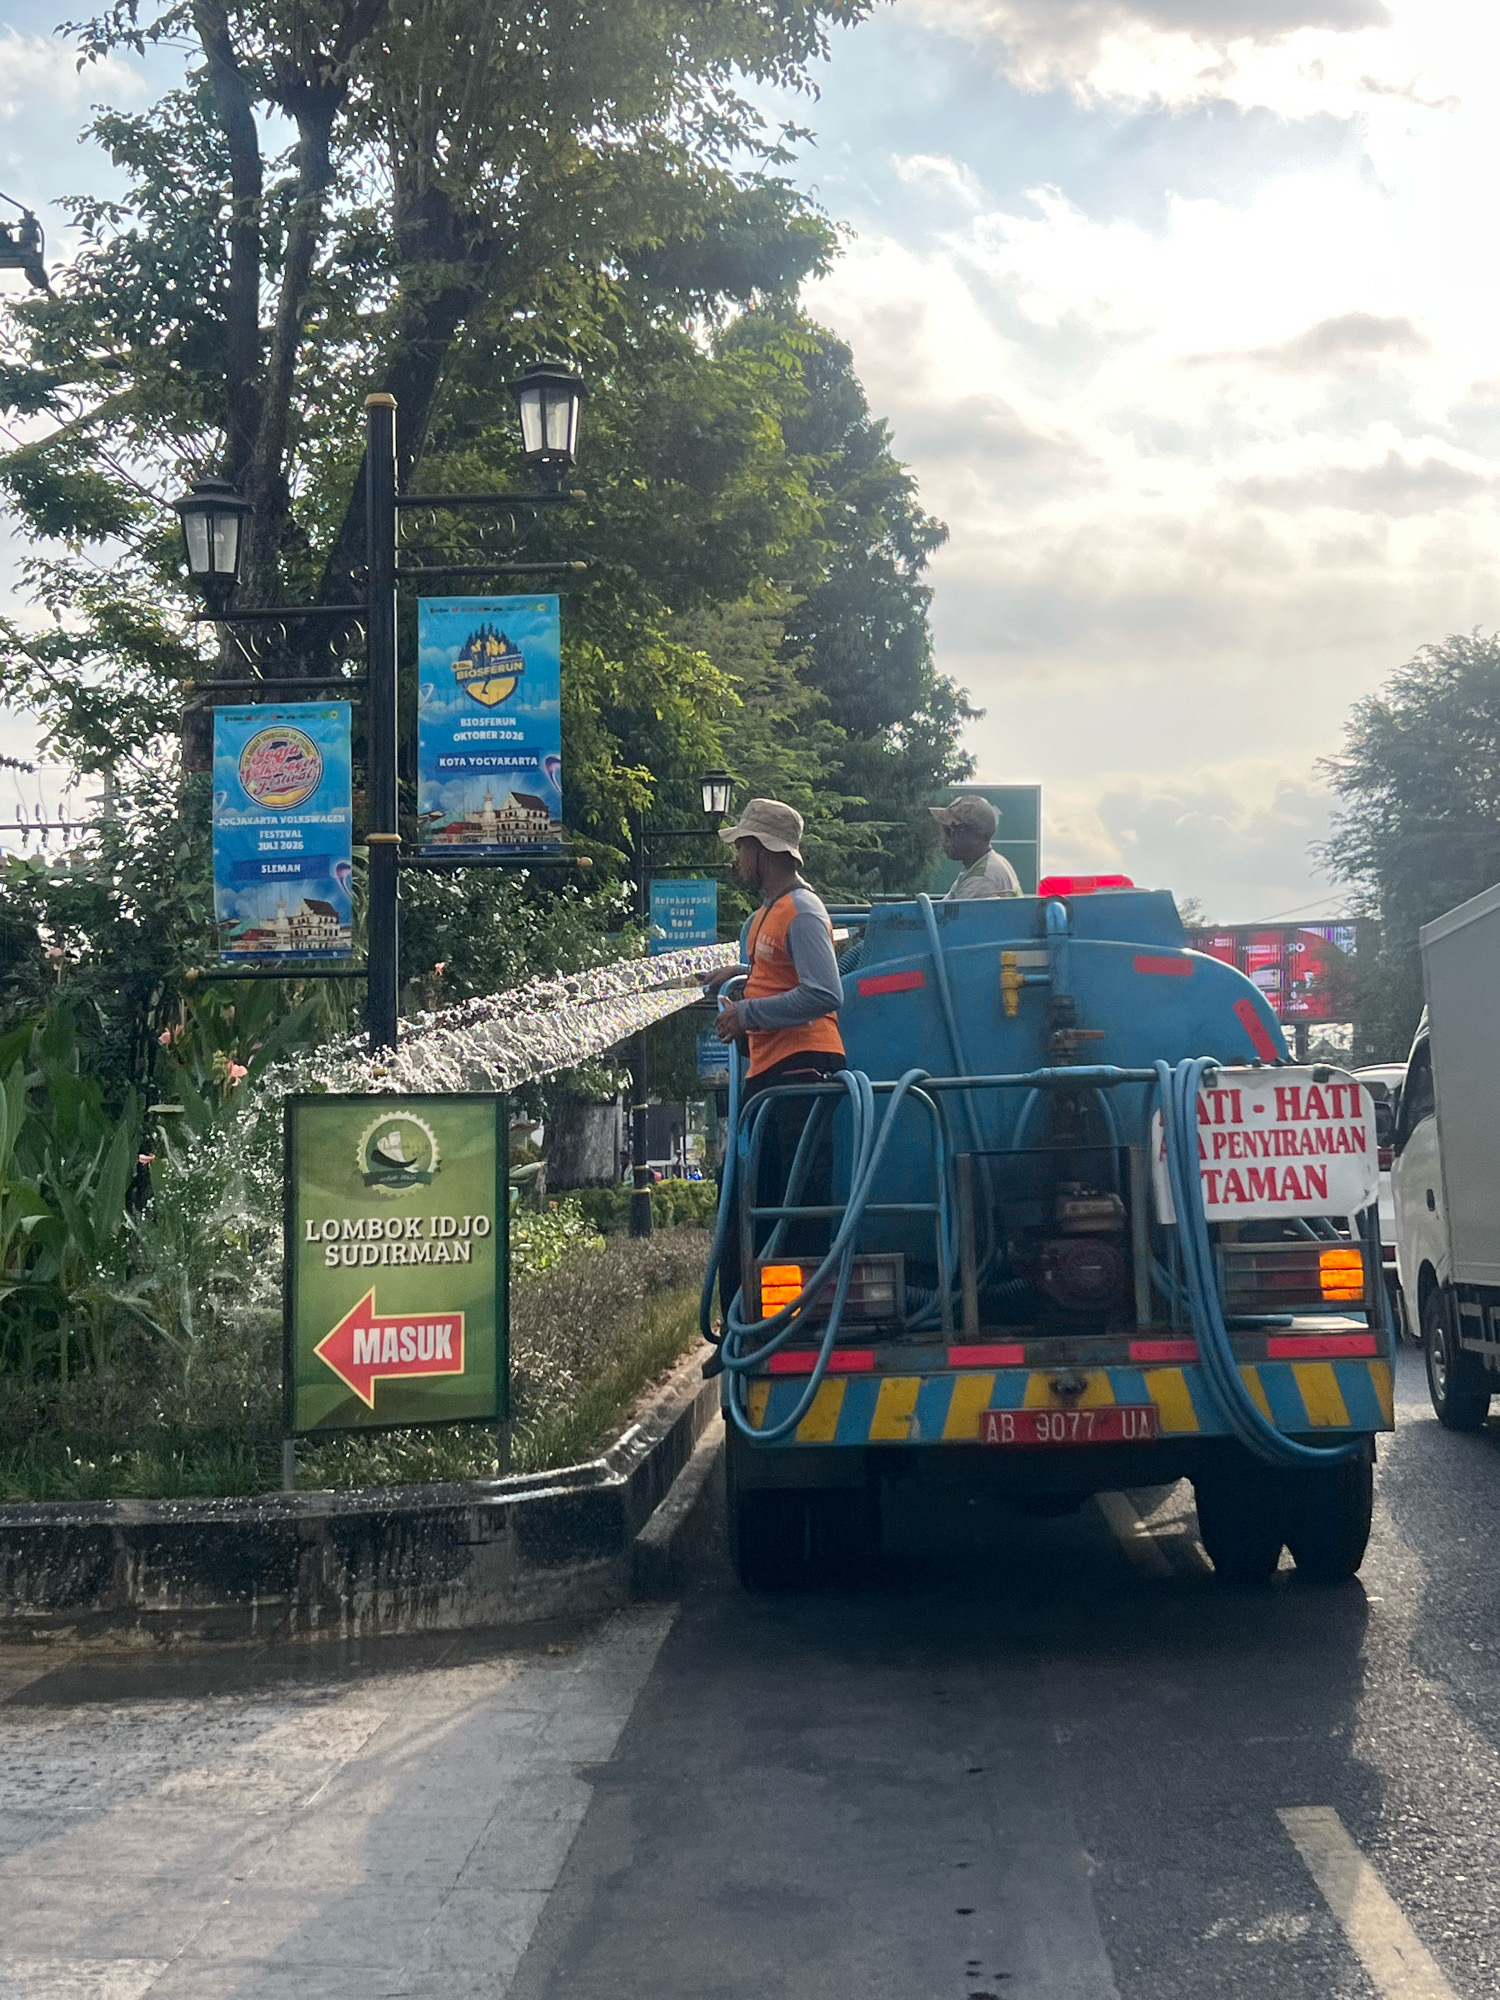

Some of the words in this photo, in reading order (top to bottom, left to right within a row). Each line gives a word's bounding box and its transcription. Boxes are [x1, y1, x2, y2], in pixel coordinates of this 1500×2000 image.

[457, 661, 524, 680] BIOSFERUN
[460, 717, 516, 727] BIOSFERUN
[453, 731, 498, 742] OKTOBER
[499, 731, 525, 741] 2026
[439, 758, 467, 767] KOTA
[468, 757, 538, 767] YOGYAKARTA
[280, 815, 346, 824] VOLKSWAGEN
[259, 829, 303, 839] FESTIVAL
[258, 841, 279, 851] JULI
[261, 864, 301, 874] SLEMAN
[1159, 1089, 1243, 1126] ATI
[1274, 1083, 1363, 1121] HATI
[1213, 1126, 1366, 1160] PENYIRAMAN
[1201, 1165, 1327, 1204] TAMAN
[305, 1217, 422, 1243] LOMBOK
[430, 1215, 490, 1238] IDJO
[325, 1240, 472, 1266] SUDIRMAN
[353, 1324, 452, 1365] MASUK
[987, 1415, 1014, 1443] AB
[1037, 1412, 1095, 1441] 9077
